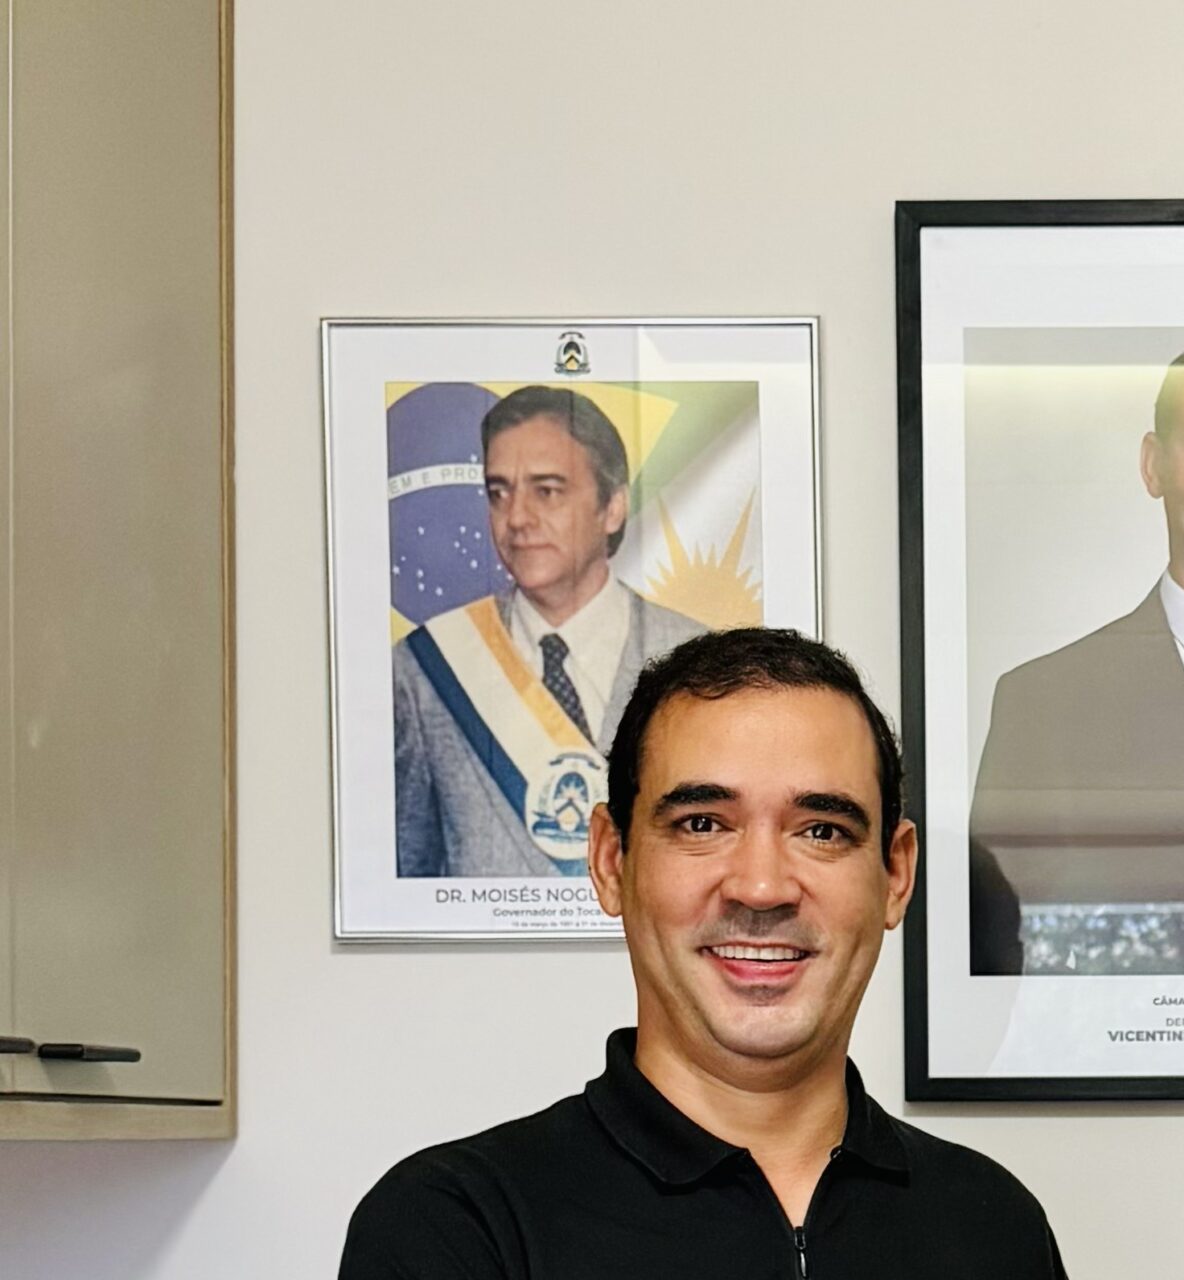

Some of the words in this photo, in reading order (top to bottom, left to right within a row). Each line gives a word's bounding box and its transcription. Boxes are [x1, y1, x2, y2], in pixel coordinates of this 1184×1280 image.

[435, 889, 466, 903] DR.
[471, 886, 541, 903] MOISÉS
[493, 907, 556, 917] Governador
[560, 907, 574, 916] do
[577, 906, 604, 916] Toca
